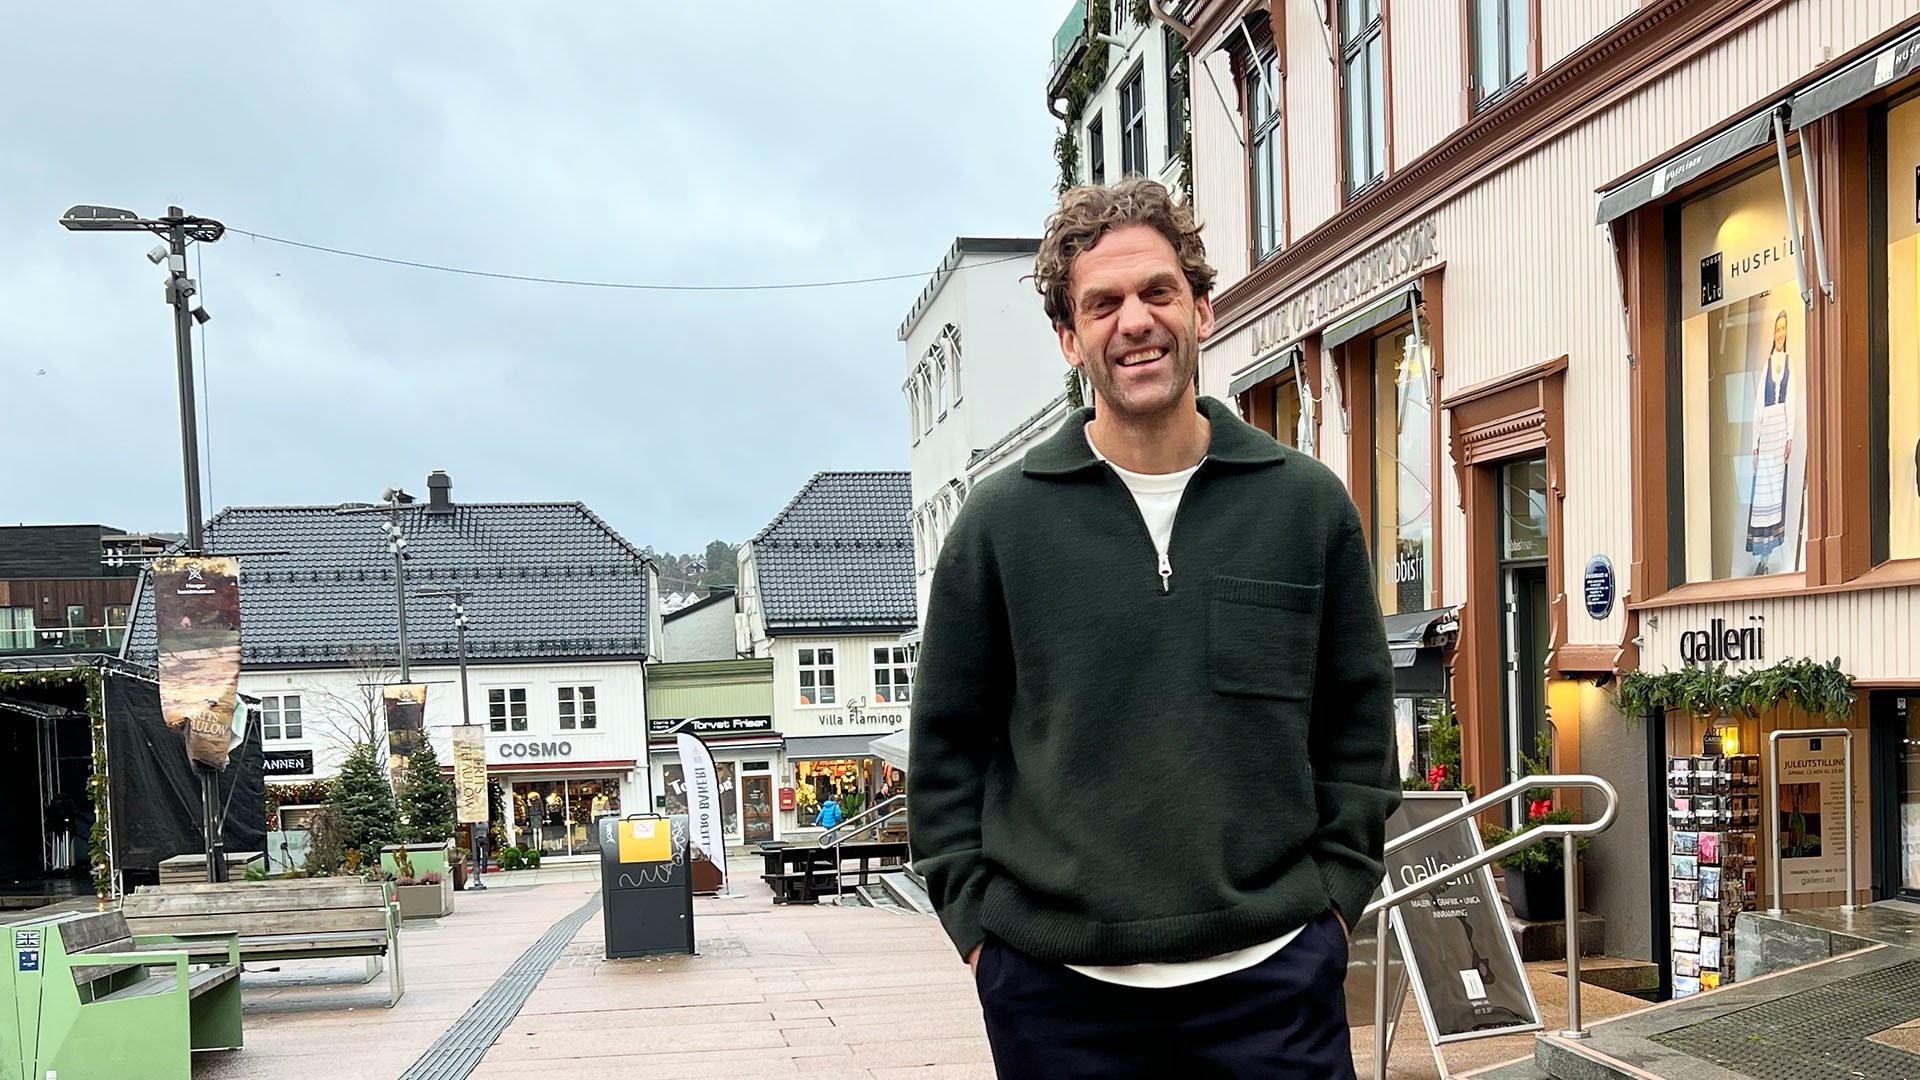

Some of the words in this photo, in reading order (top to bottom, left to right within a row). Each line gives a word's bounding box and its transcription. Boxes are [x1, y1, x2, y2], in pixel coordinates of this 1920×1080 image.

[1292, 294, 1314, 332] OG
[690, 720, 730, 730] Torvet
[819, 713, 843, 725] Villa
[849, 712, 902, 726] Flamingo
[499, 741, 572, 759] COSMO
[262, 758, 305, 770] ANNEN
